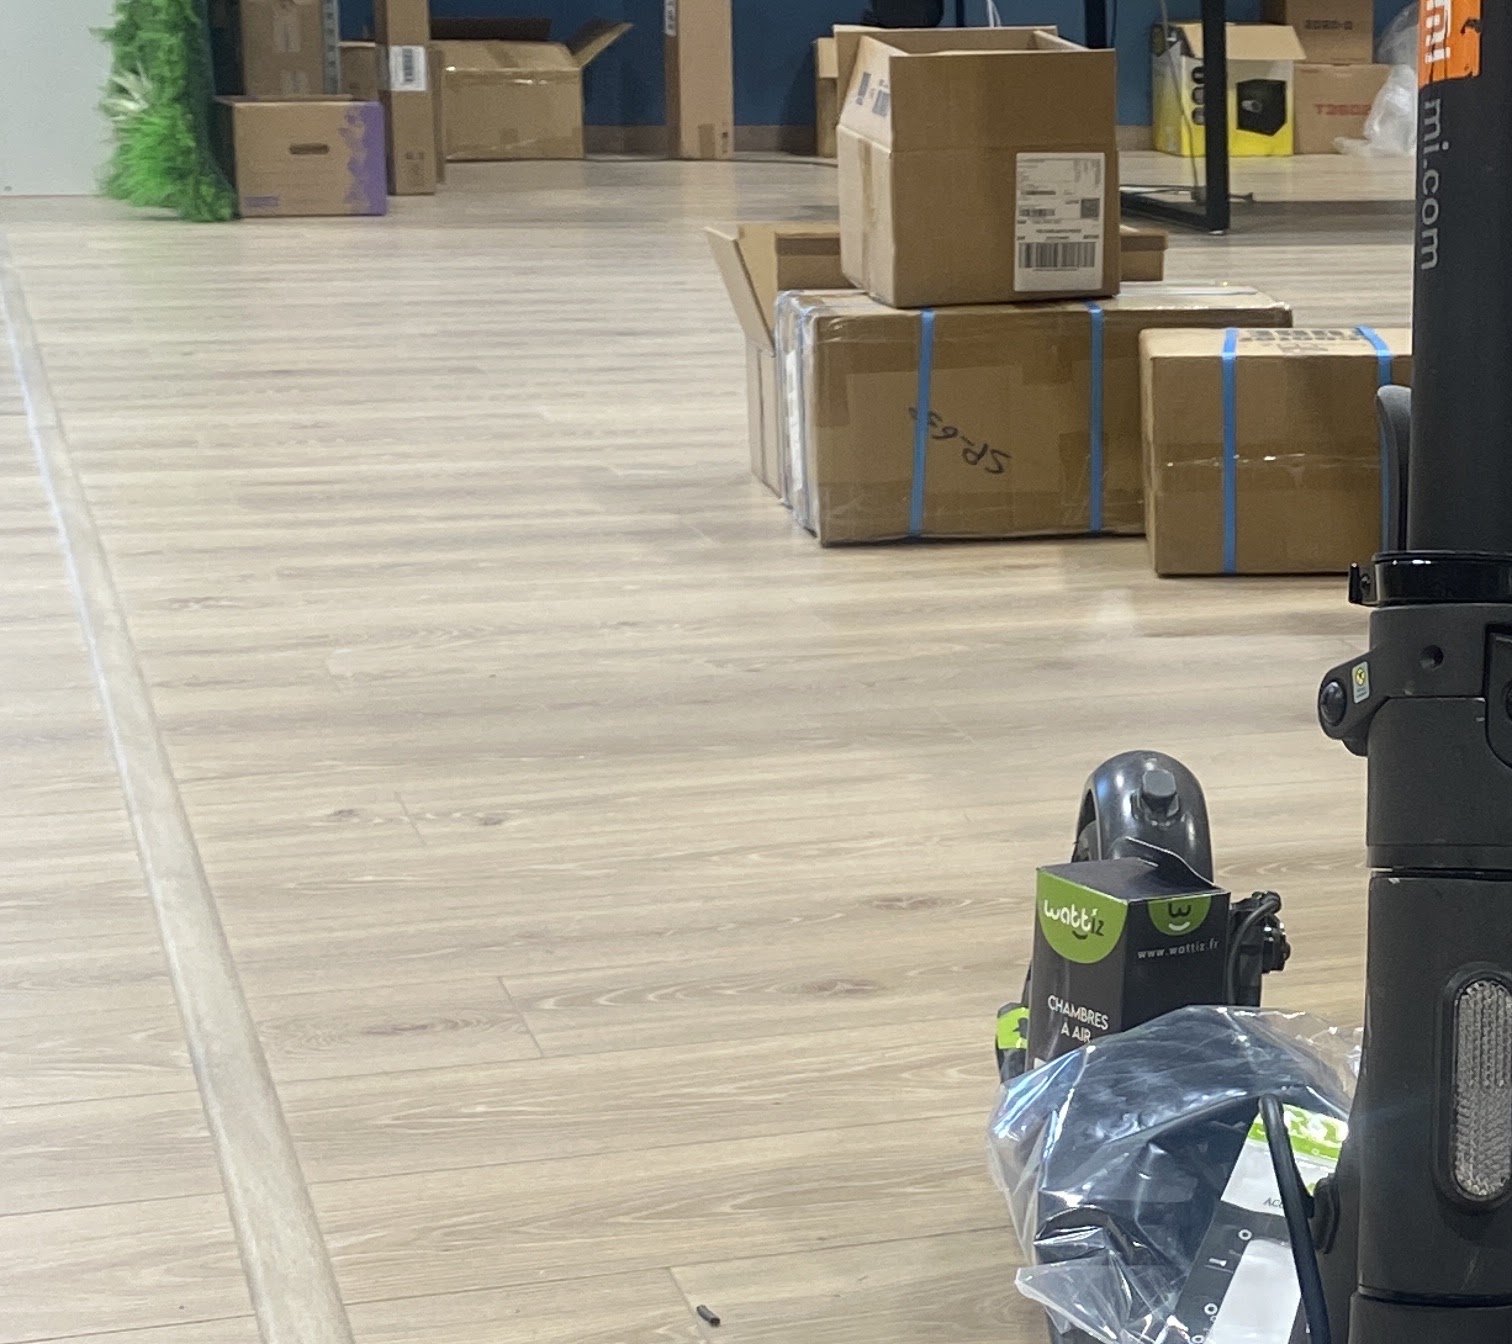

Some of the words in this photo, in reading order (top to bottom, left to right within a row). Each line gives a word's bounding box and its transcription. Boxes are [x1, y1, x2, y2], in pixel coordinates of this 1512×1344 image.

[1421, 98, 1449, 270] mi.com
[1044, 900, 1104, 936] wattiz
[1137, 938, 1219, 959] www.wattiz.fr
[1047, 995, 1108, 1030] CHAMBRES
[1073, 1028, 1091, 1042] AIR
